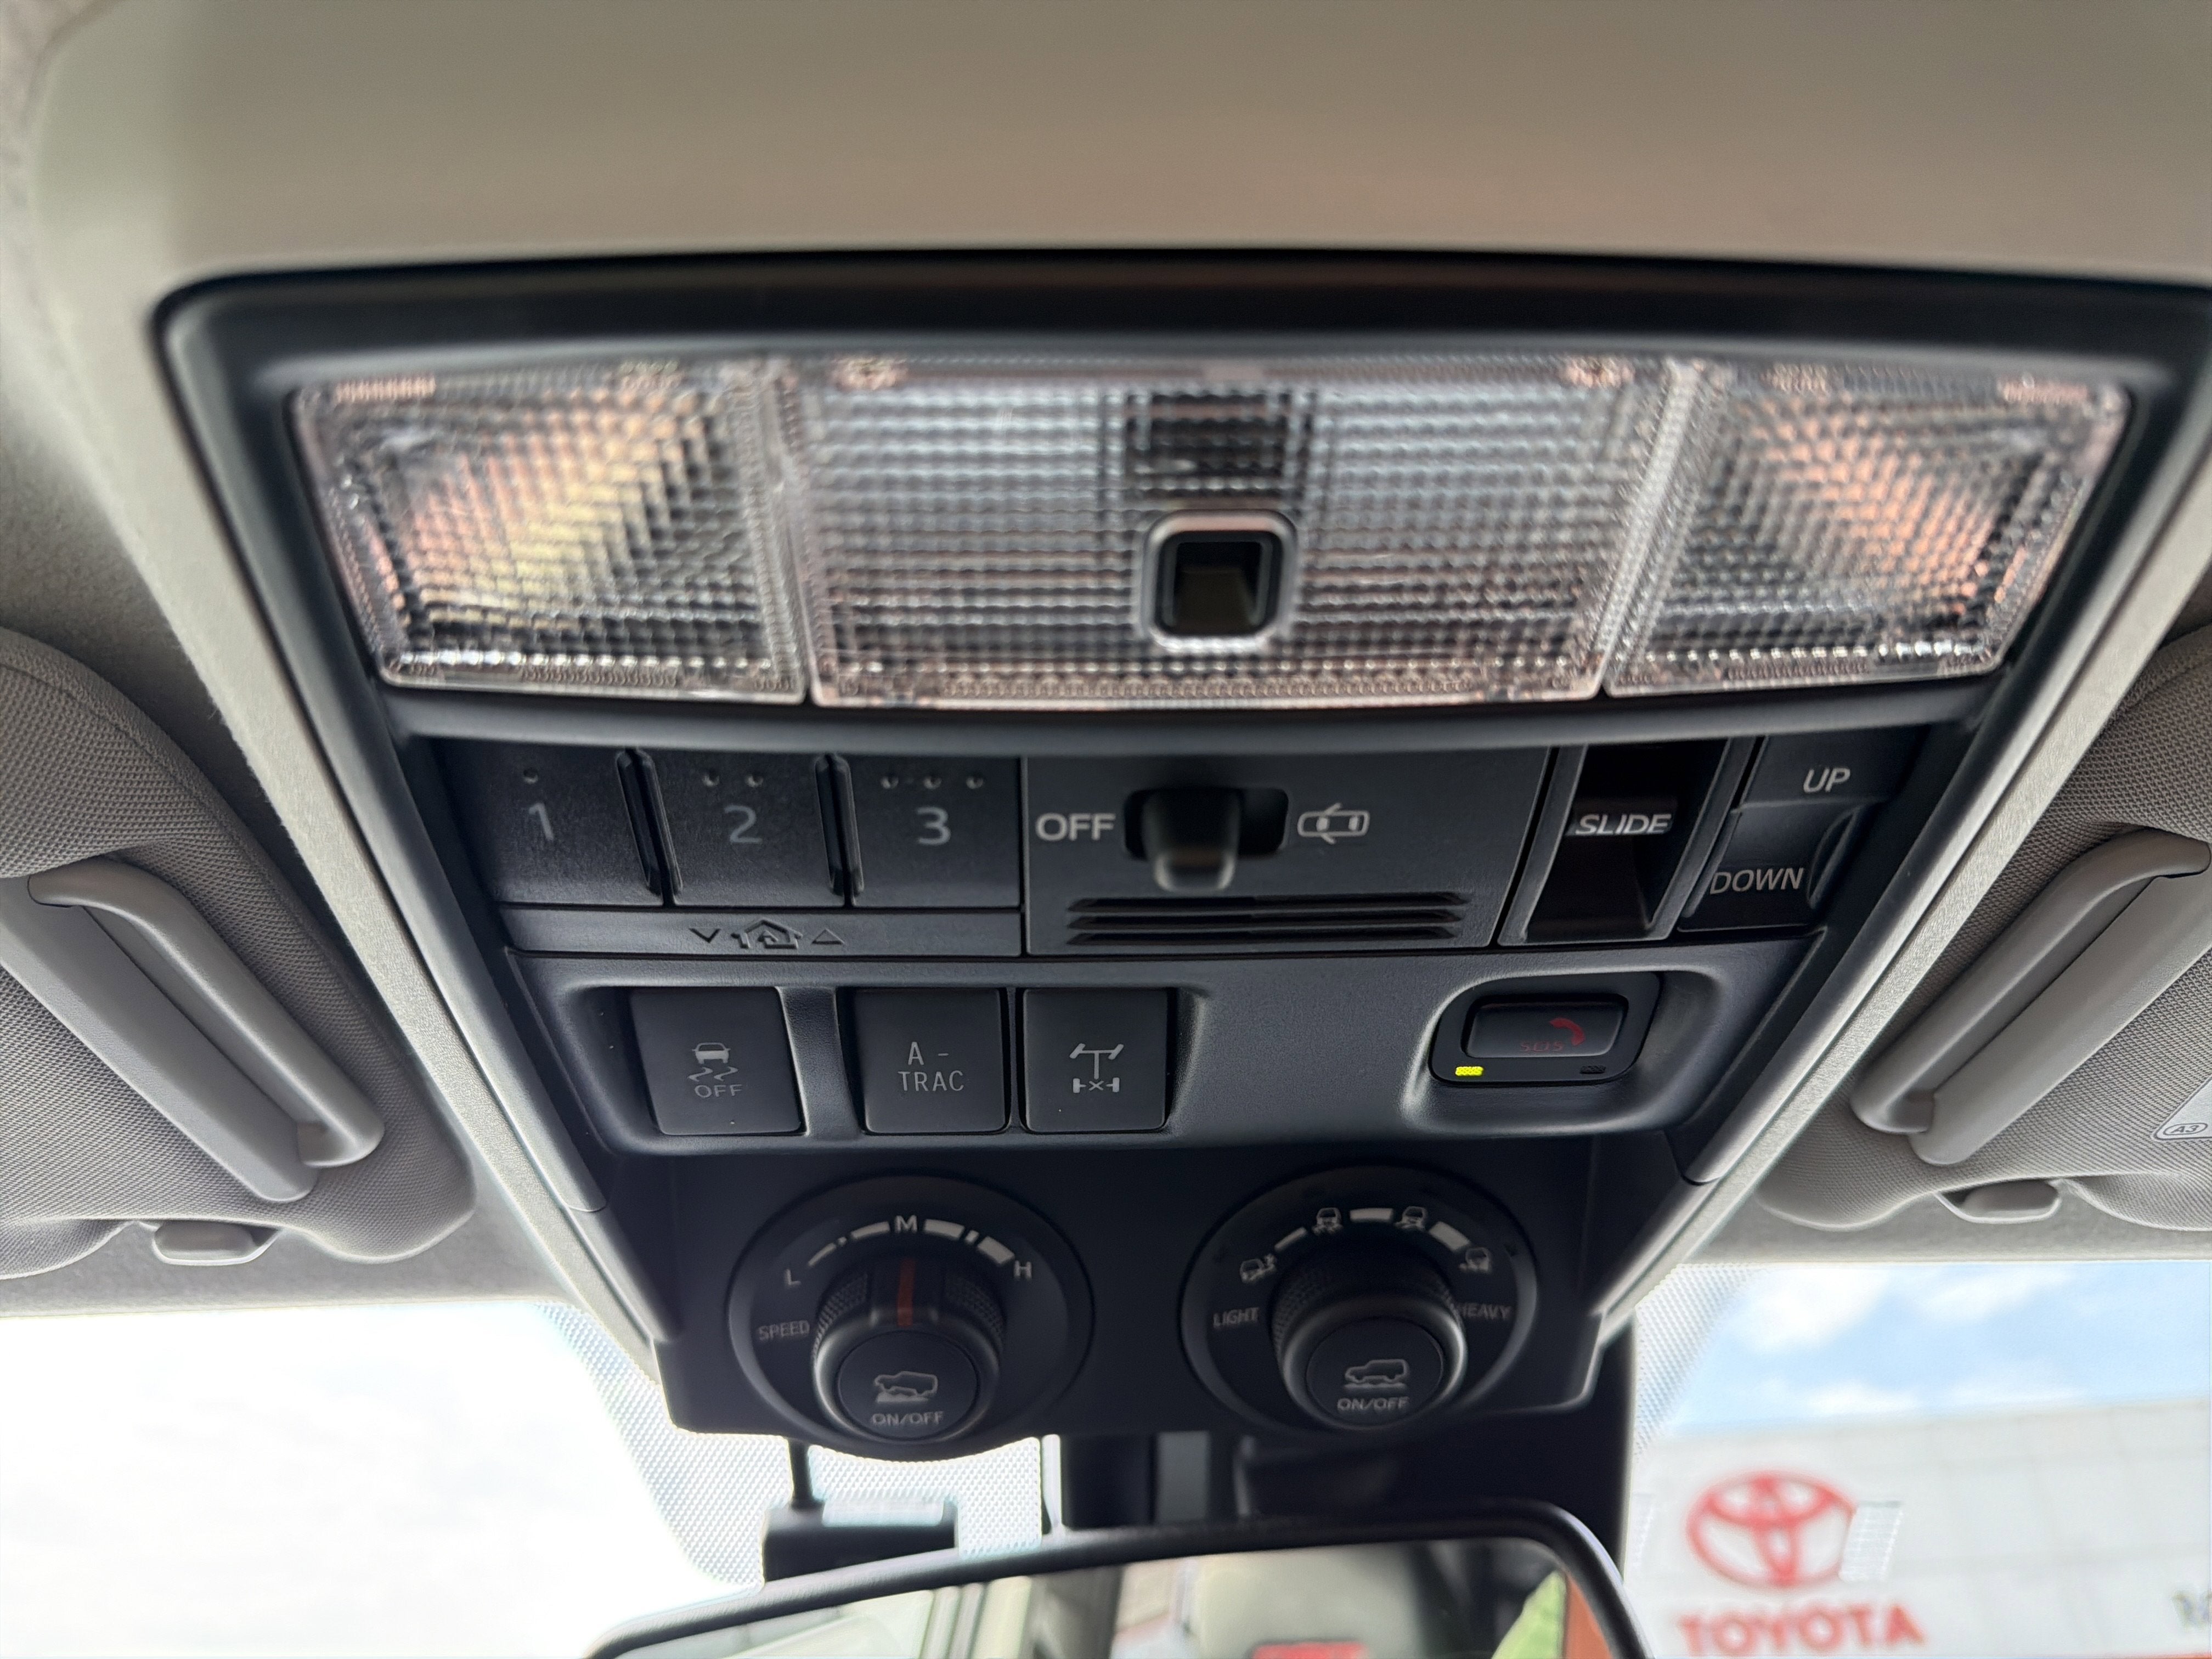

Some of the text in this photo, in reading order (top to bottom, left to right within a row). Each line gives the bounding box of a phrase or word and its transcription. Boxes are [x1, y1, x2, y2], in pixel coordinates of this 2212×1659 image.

[1802, 768, 1851, 794] UP
[527, 802, 554, 841] 1
[724, 805, 763, 844] 2
[916, 806, 951, 845] 3
[1035, 812, 1116, 842] OFF
[1575, 812, 1672, 836] SLIDE
[1709, 867, 1804, 895] DOWN
[1520, 1041, 1564, 1052] SOS
[694, 1084, 743, 1098] OFF
[898, 1070, 964, 1092] TRAC
[894, 1215, 918, 1233] M
[784, 1269, 801, 1288] L
[1013, 1262, 1032, 1280] H
[1213, 1306, 1260, 1329] LIGHT
[757, 1319, 811, 1342] SPEED
[1337, 1396, 1410, 1412] ON/OFF
[870, 1410, 945, 1426] ON/OFF
[1675, 1603, 1928, 1659] TOYOTA
